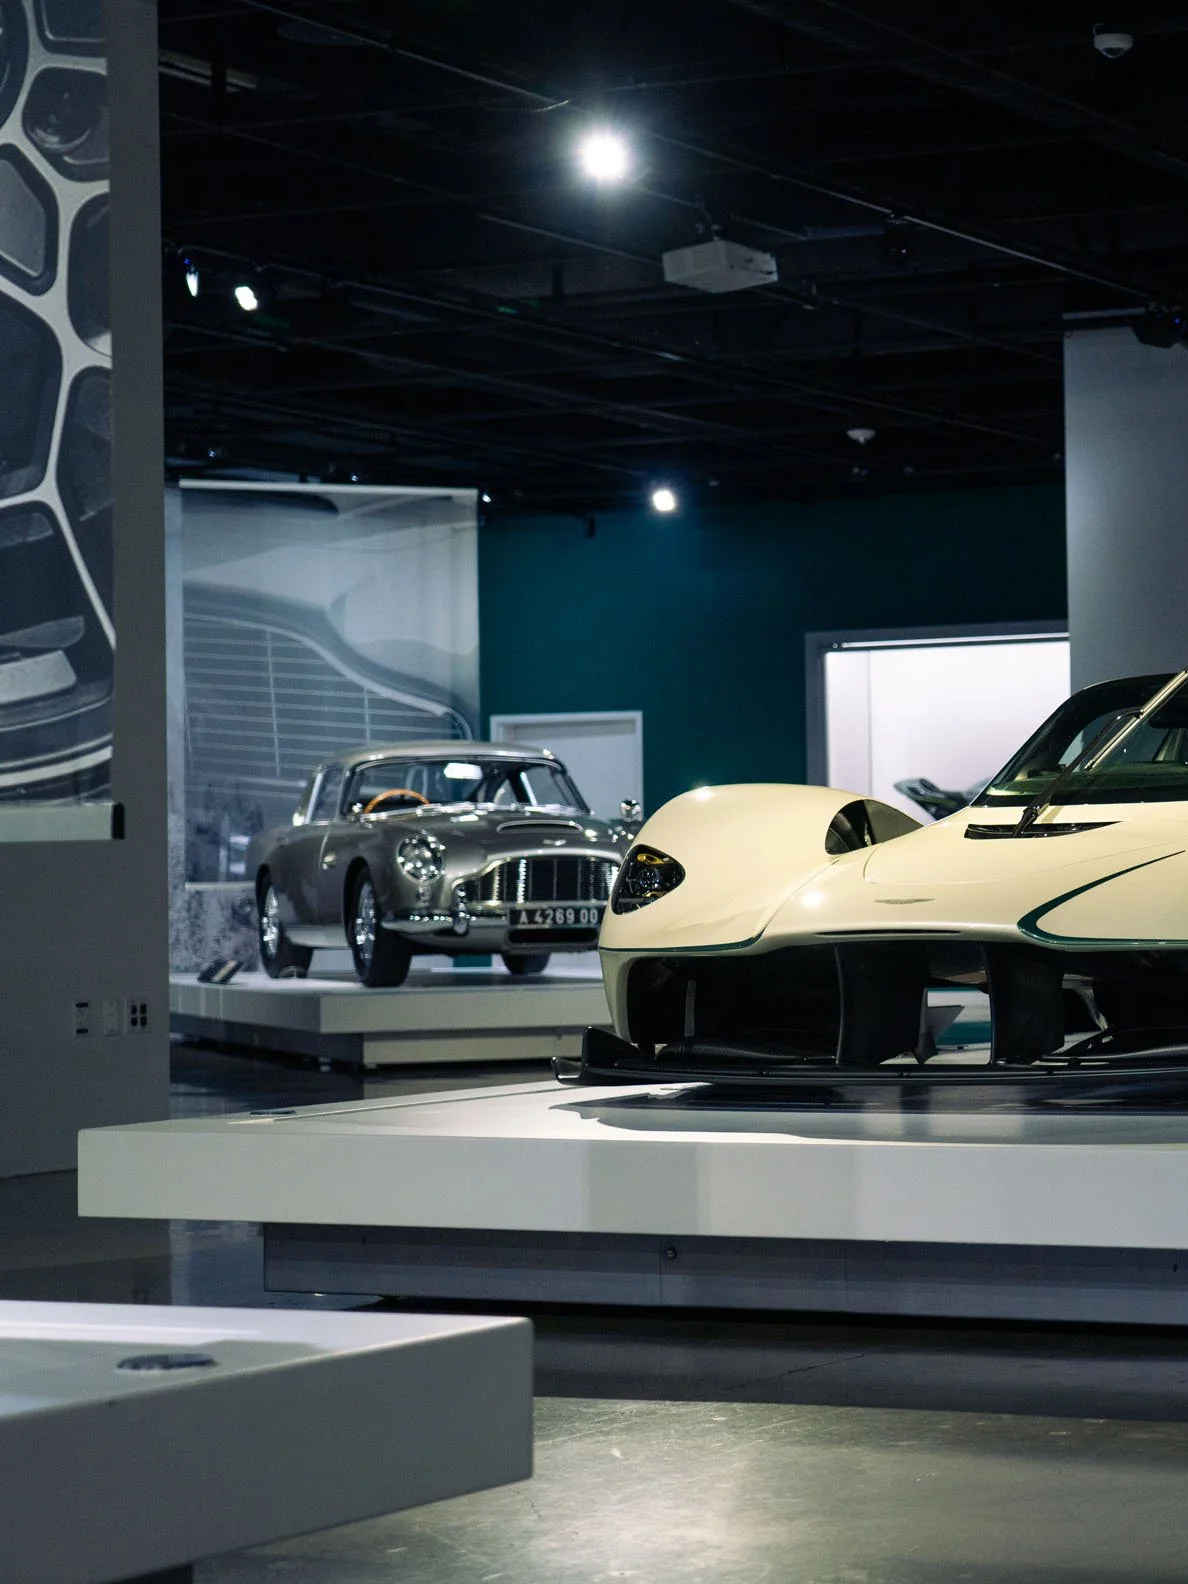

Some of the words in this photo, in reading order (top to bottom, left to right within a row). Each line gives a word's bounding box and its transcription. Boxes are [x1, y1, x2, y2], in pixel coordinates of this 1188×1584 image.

[520, 910, 529, 925] A
[534, 908, 575, 925] 4269
[580, 908, 599, 925] 00
